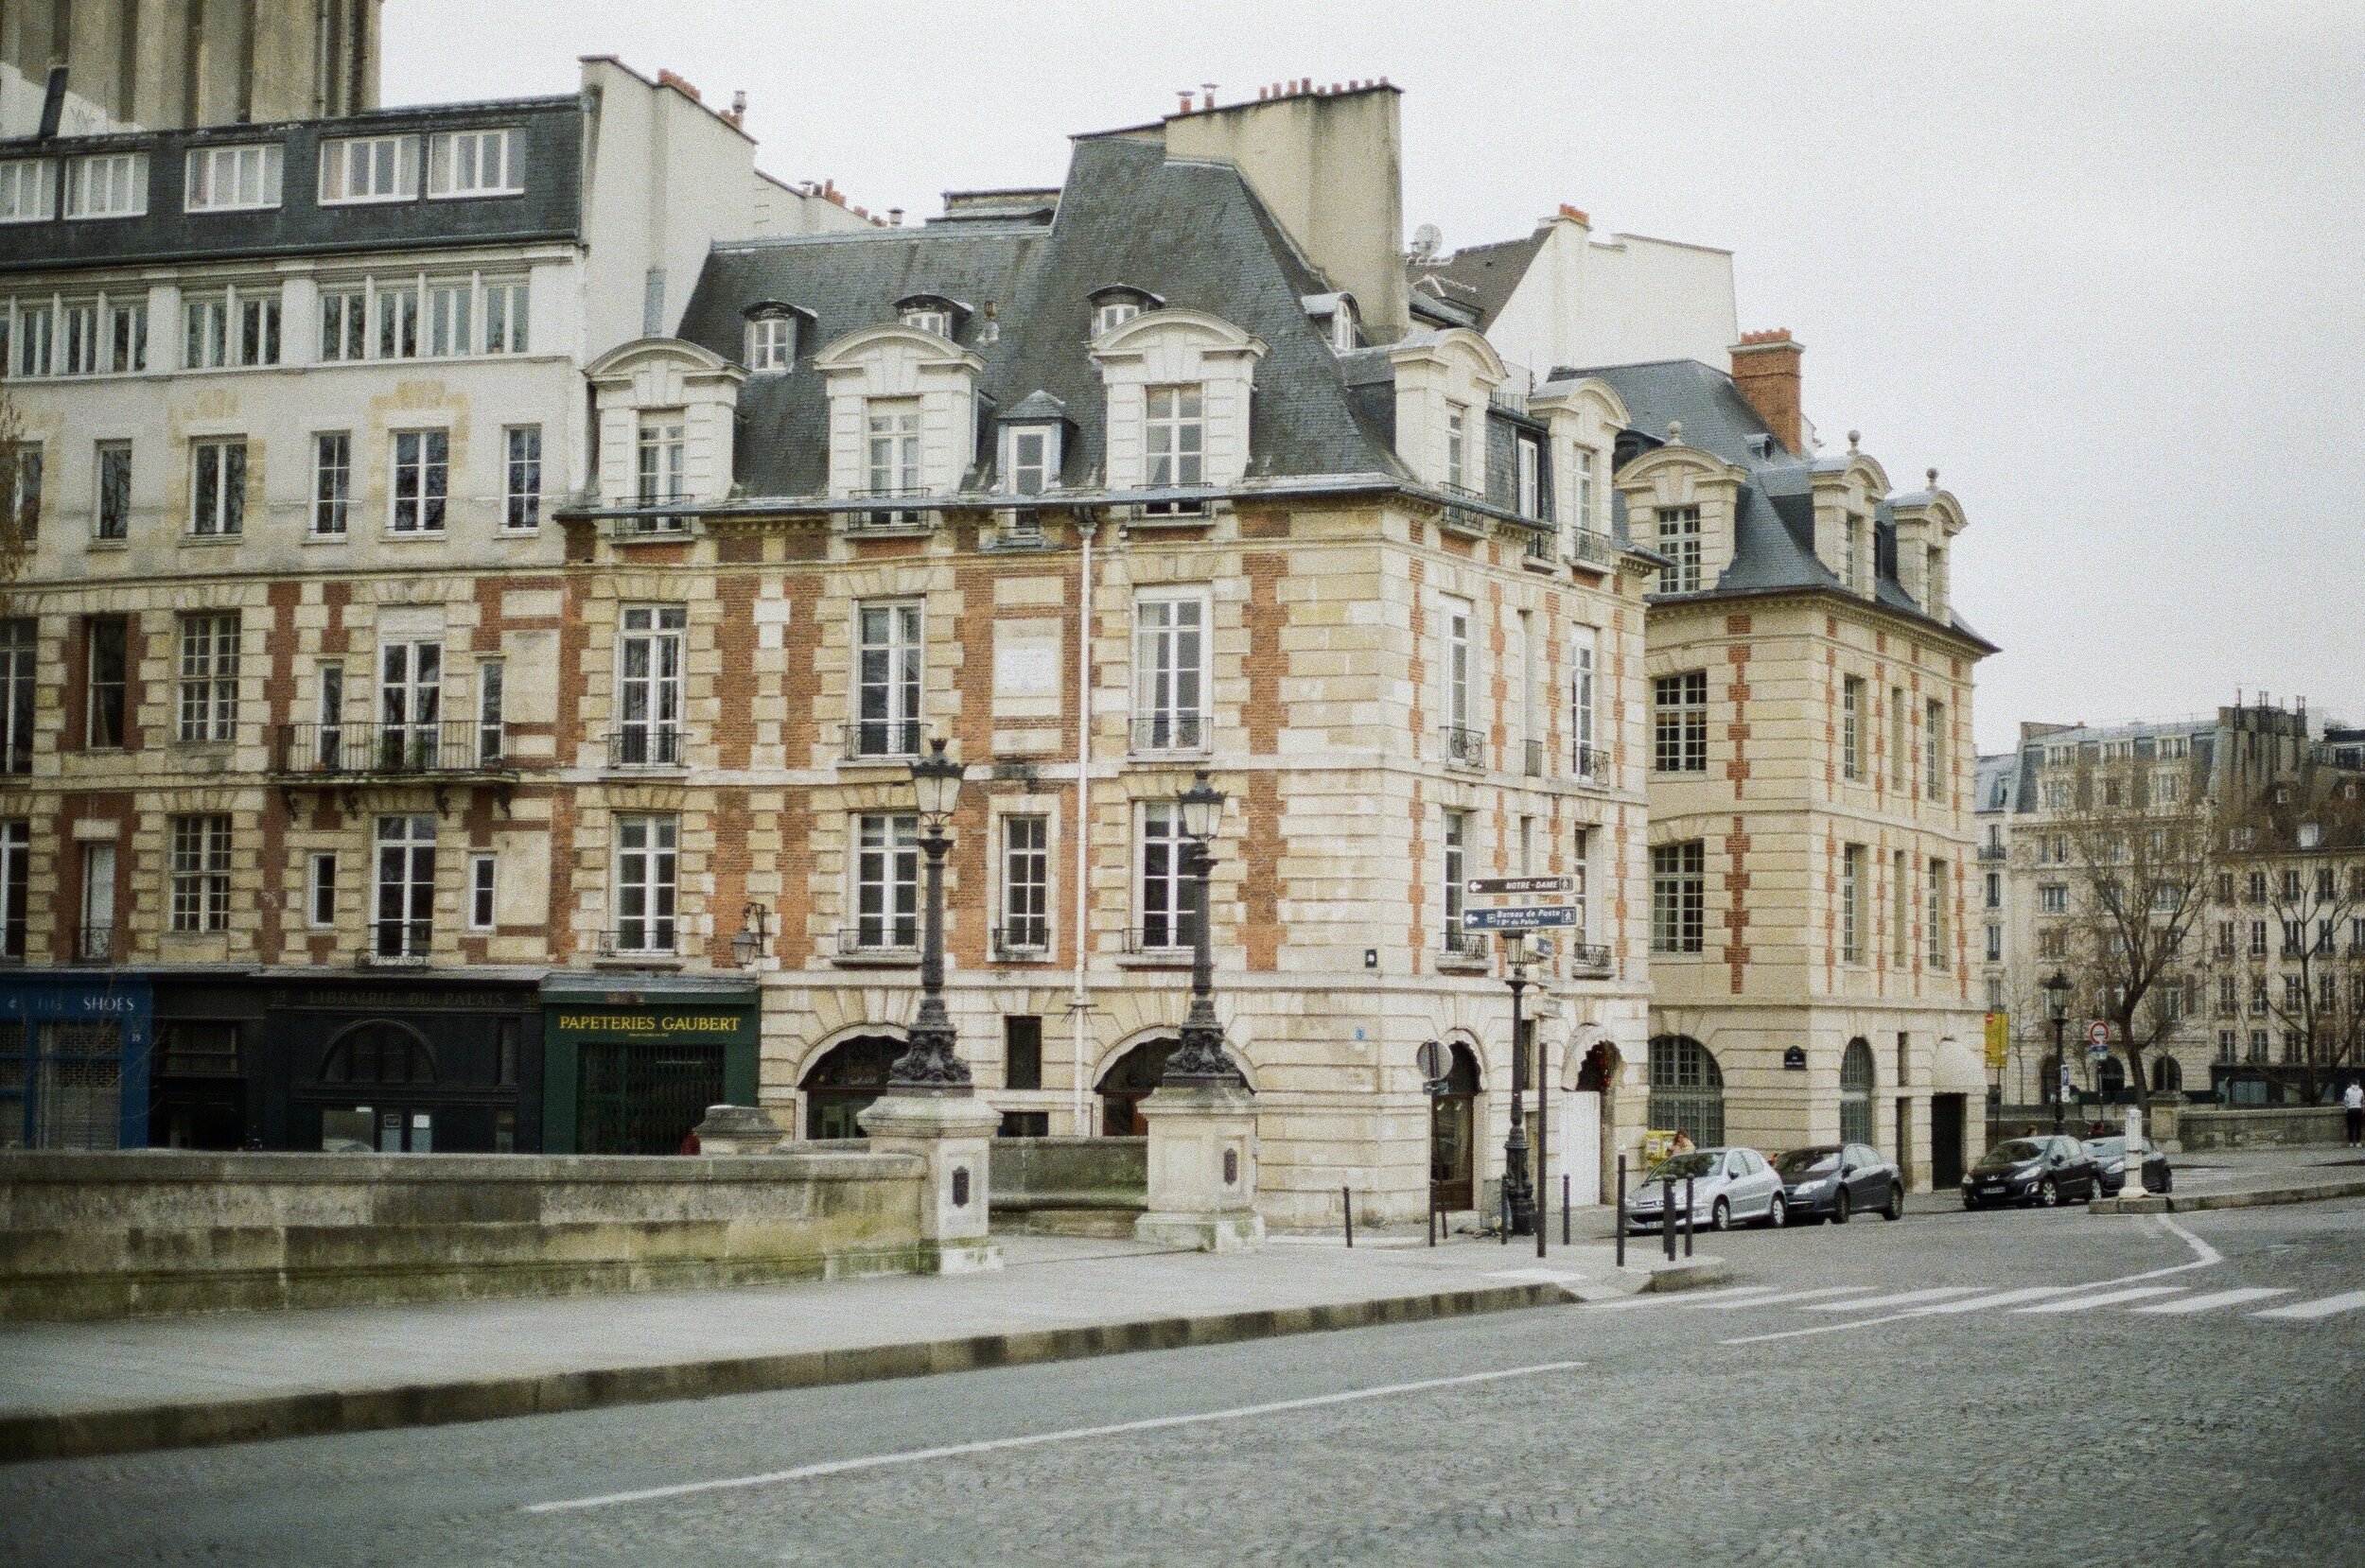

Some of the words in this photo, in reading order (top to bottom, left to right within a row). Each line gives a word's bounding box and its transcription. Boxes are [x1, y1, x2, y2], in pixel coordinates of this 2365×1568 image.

[1538, 909, 1561, 917] Poste
[83, 997, 134, 1011] SHOES
[308, 991, 395, 1004] LIBRAIRIE
[408, 992, 431, 1004] DU
[444, 992, 506, 1005] PALAIS
[559, 1016, 656, 1031] PAPETERIES
[661, 1017, 742, 1032] GAUBERT
